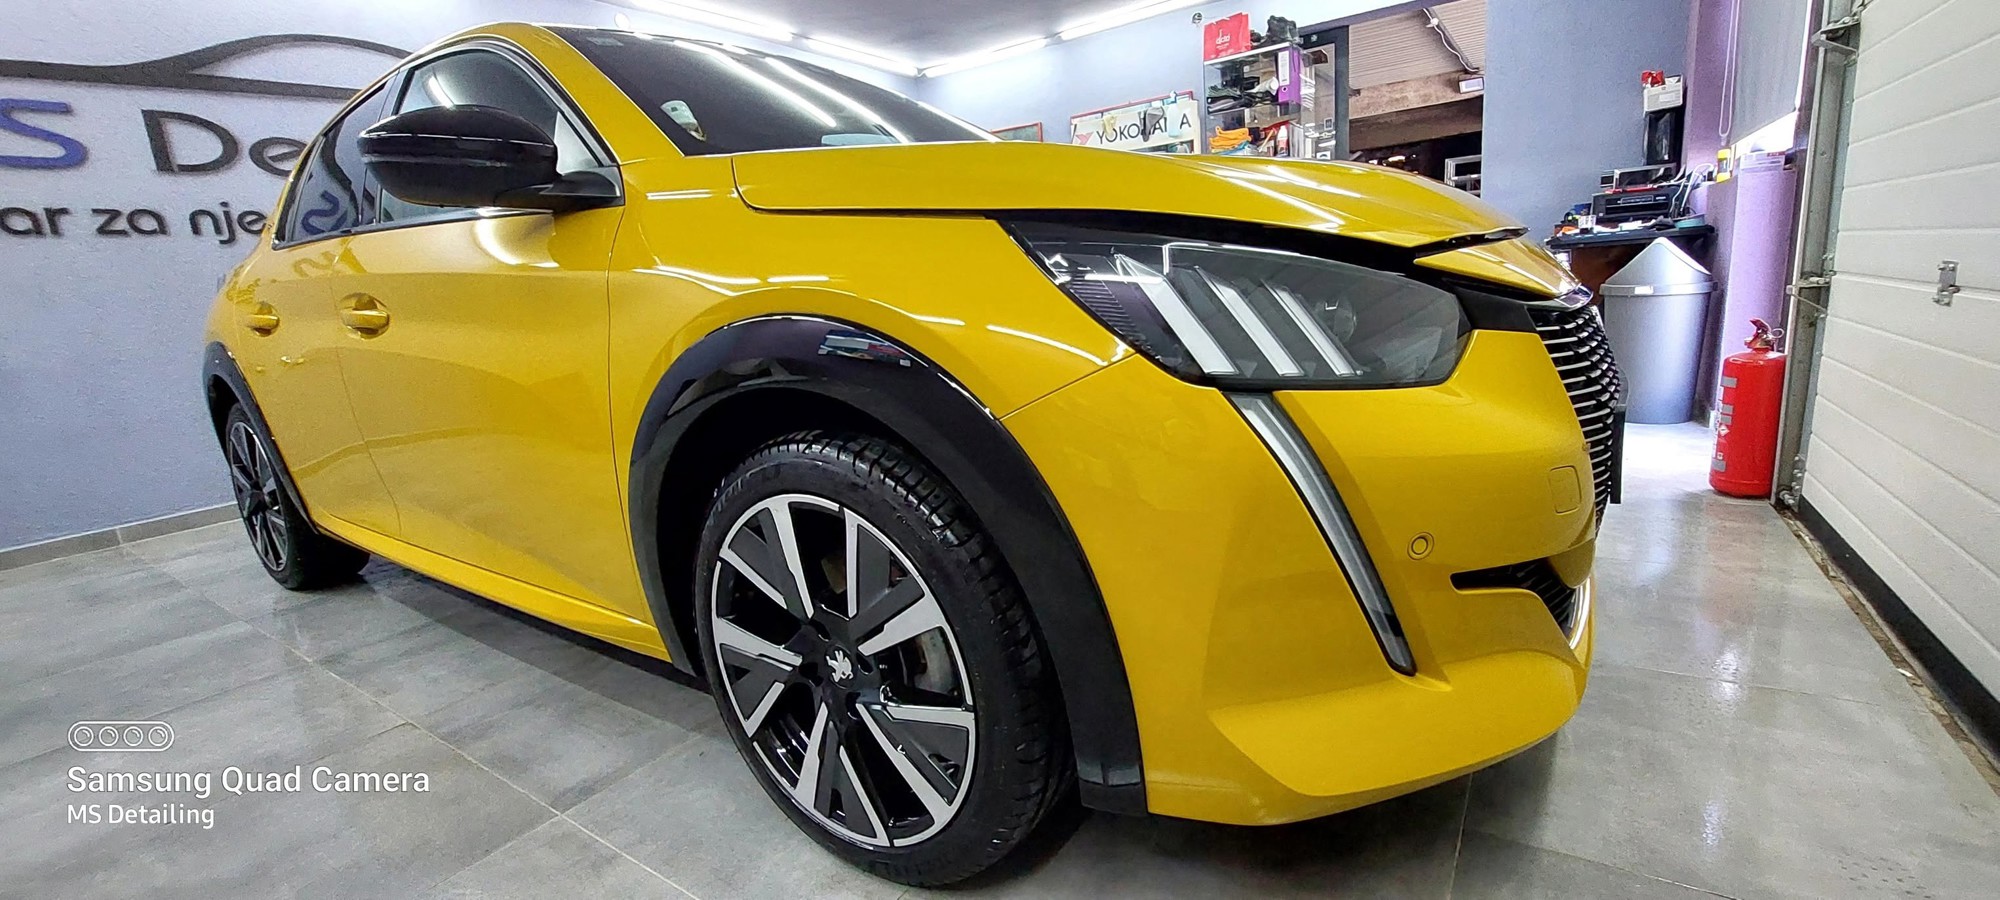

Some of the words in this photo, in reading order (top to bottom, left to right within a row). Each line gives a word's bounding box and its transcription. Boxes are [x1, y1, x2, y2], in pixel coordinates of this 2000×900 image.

[0, 98, 87, 170] S
[1096, 112, 1192, 144] YOKOAA
[0, 206, 70, 236] ar
[92, 208, 169, 236] za
